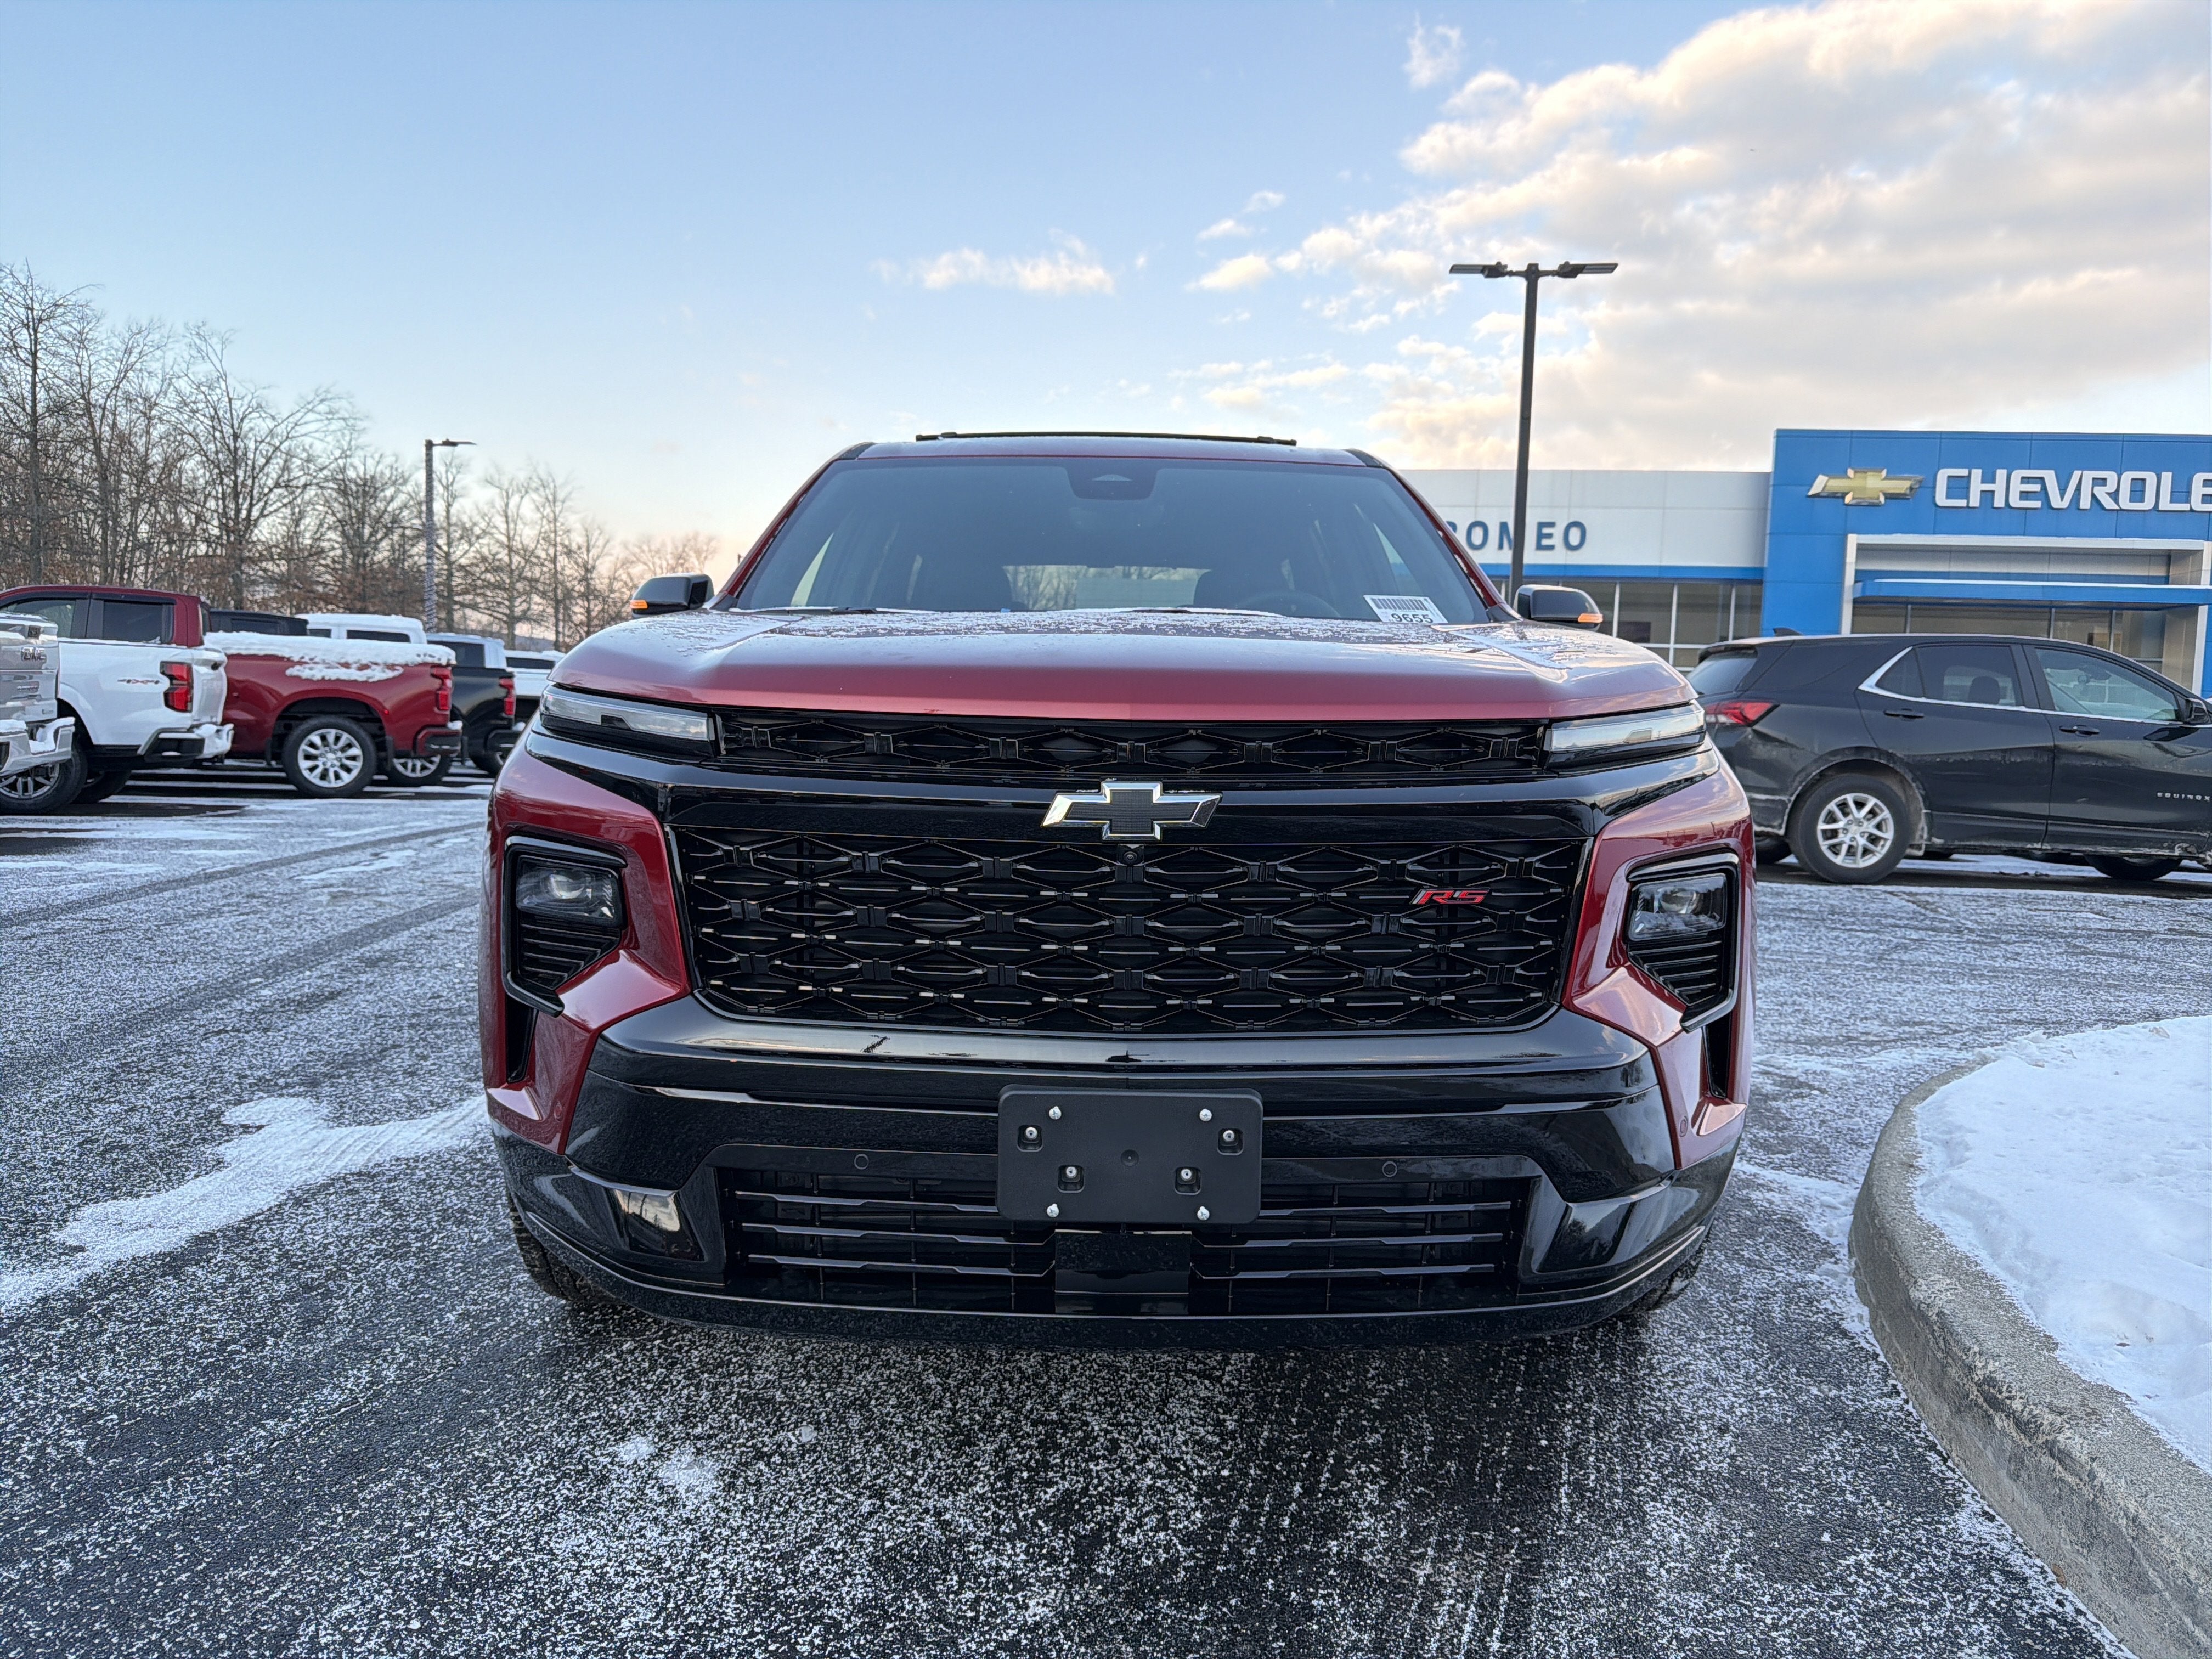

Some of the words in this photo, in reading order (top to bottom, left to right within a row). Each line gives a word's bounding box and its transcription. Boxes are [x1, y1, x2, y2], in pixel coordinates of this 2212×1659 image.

[1445, 521, 1587, 551] OMEO
[1391, 613, 1433, 623] 9655
[2157, 792, 2210, 802] EQUINOX
[1415, 889, 1489, 904] RS
